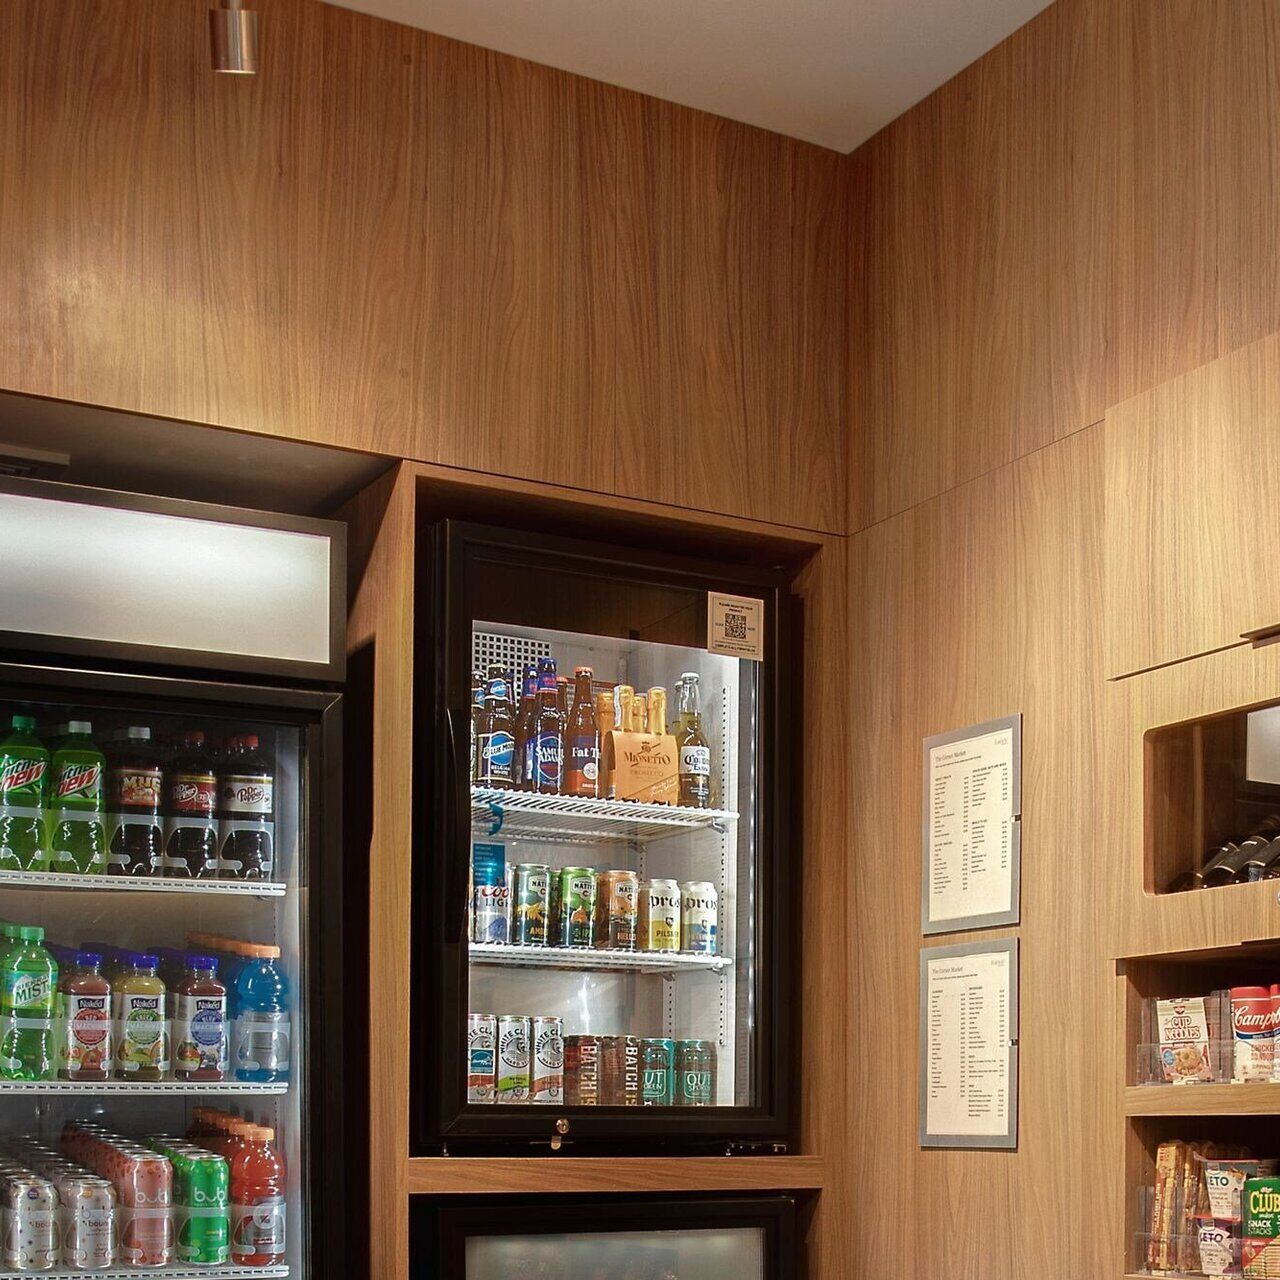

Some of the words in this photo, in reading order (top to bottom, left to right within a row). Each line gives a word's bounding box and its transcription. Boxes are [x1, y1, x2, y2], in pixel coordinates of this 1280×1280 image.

[572, 747, 589, 758] Fat
[121, 775, 161, 792] MUG
[238, 788, 264, 803] Pepper
[15, 981, 50, 1004] MIST
[79, 999, 103, 1009] Naked
[132, 999, 157, 1009] Naked
[198, 1001, 221, 1010] Naked
[1171, 1016, 1192, 1028] CUP
[1164, 1026, 1201, 1040] NOODLES
[499, 1030, 514, 1055] WHITE
[535, 1030, 550, 1055] WHITE
[580, 1045, 598, 1090] BATCH
[625, 1045, 639, 1091] BATCH
[1248, 1220, 1271, 1228] SNACK
